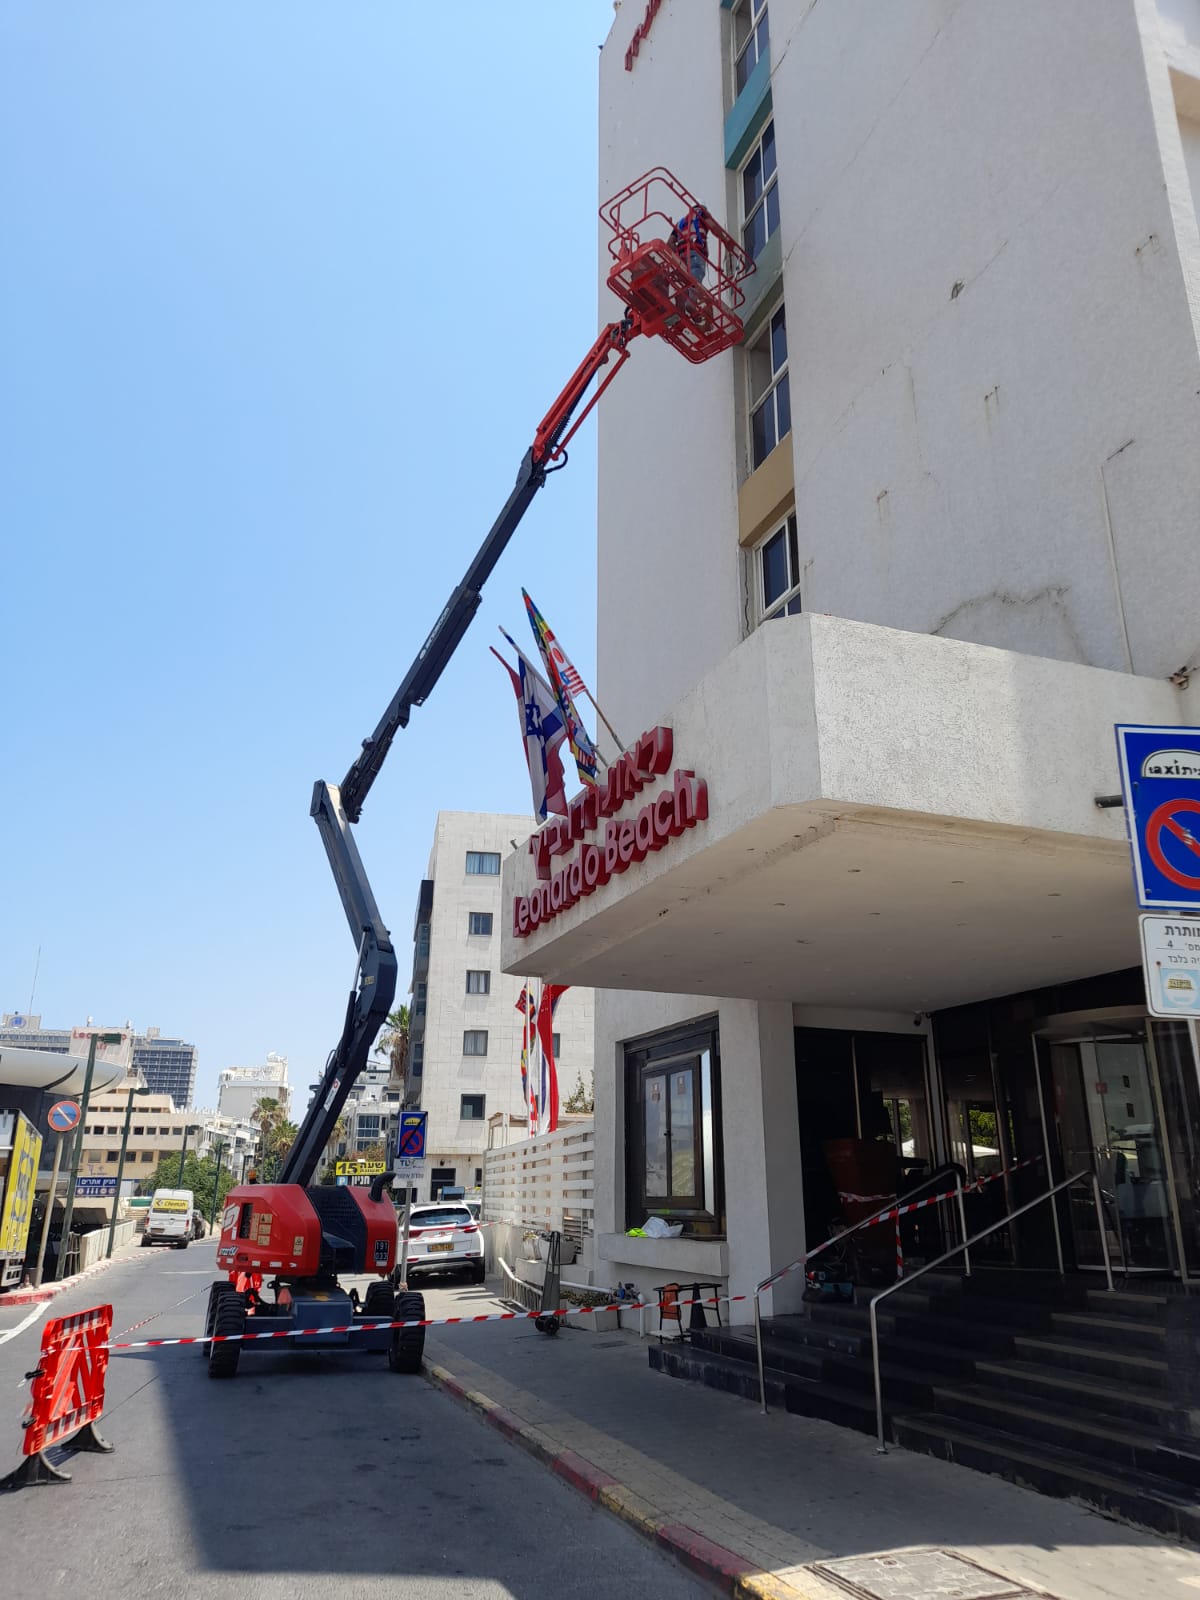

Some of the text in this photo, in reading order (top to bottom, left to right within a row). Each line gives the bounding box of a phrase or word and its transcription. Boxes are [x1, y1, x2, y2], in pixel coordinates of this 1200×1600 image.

[1149, 760, 1180, 775] taxi
[513, 768, 709, 938] Leonardo Beach
[1167, 954, 1189, 963] בלבד
[338, 1162, 358, 1174] 15
[351, 1176, 370, 1186] חניון
